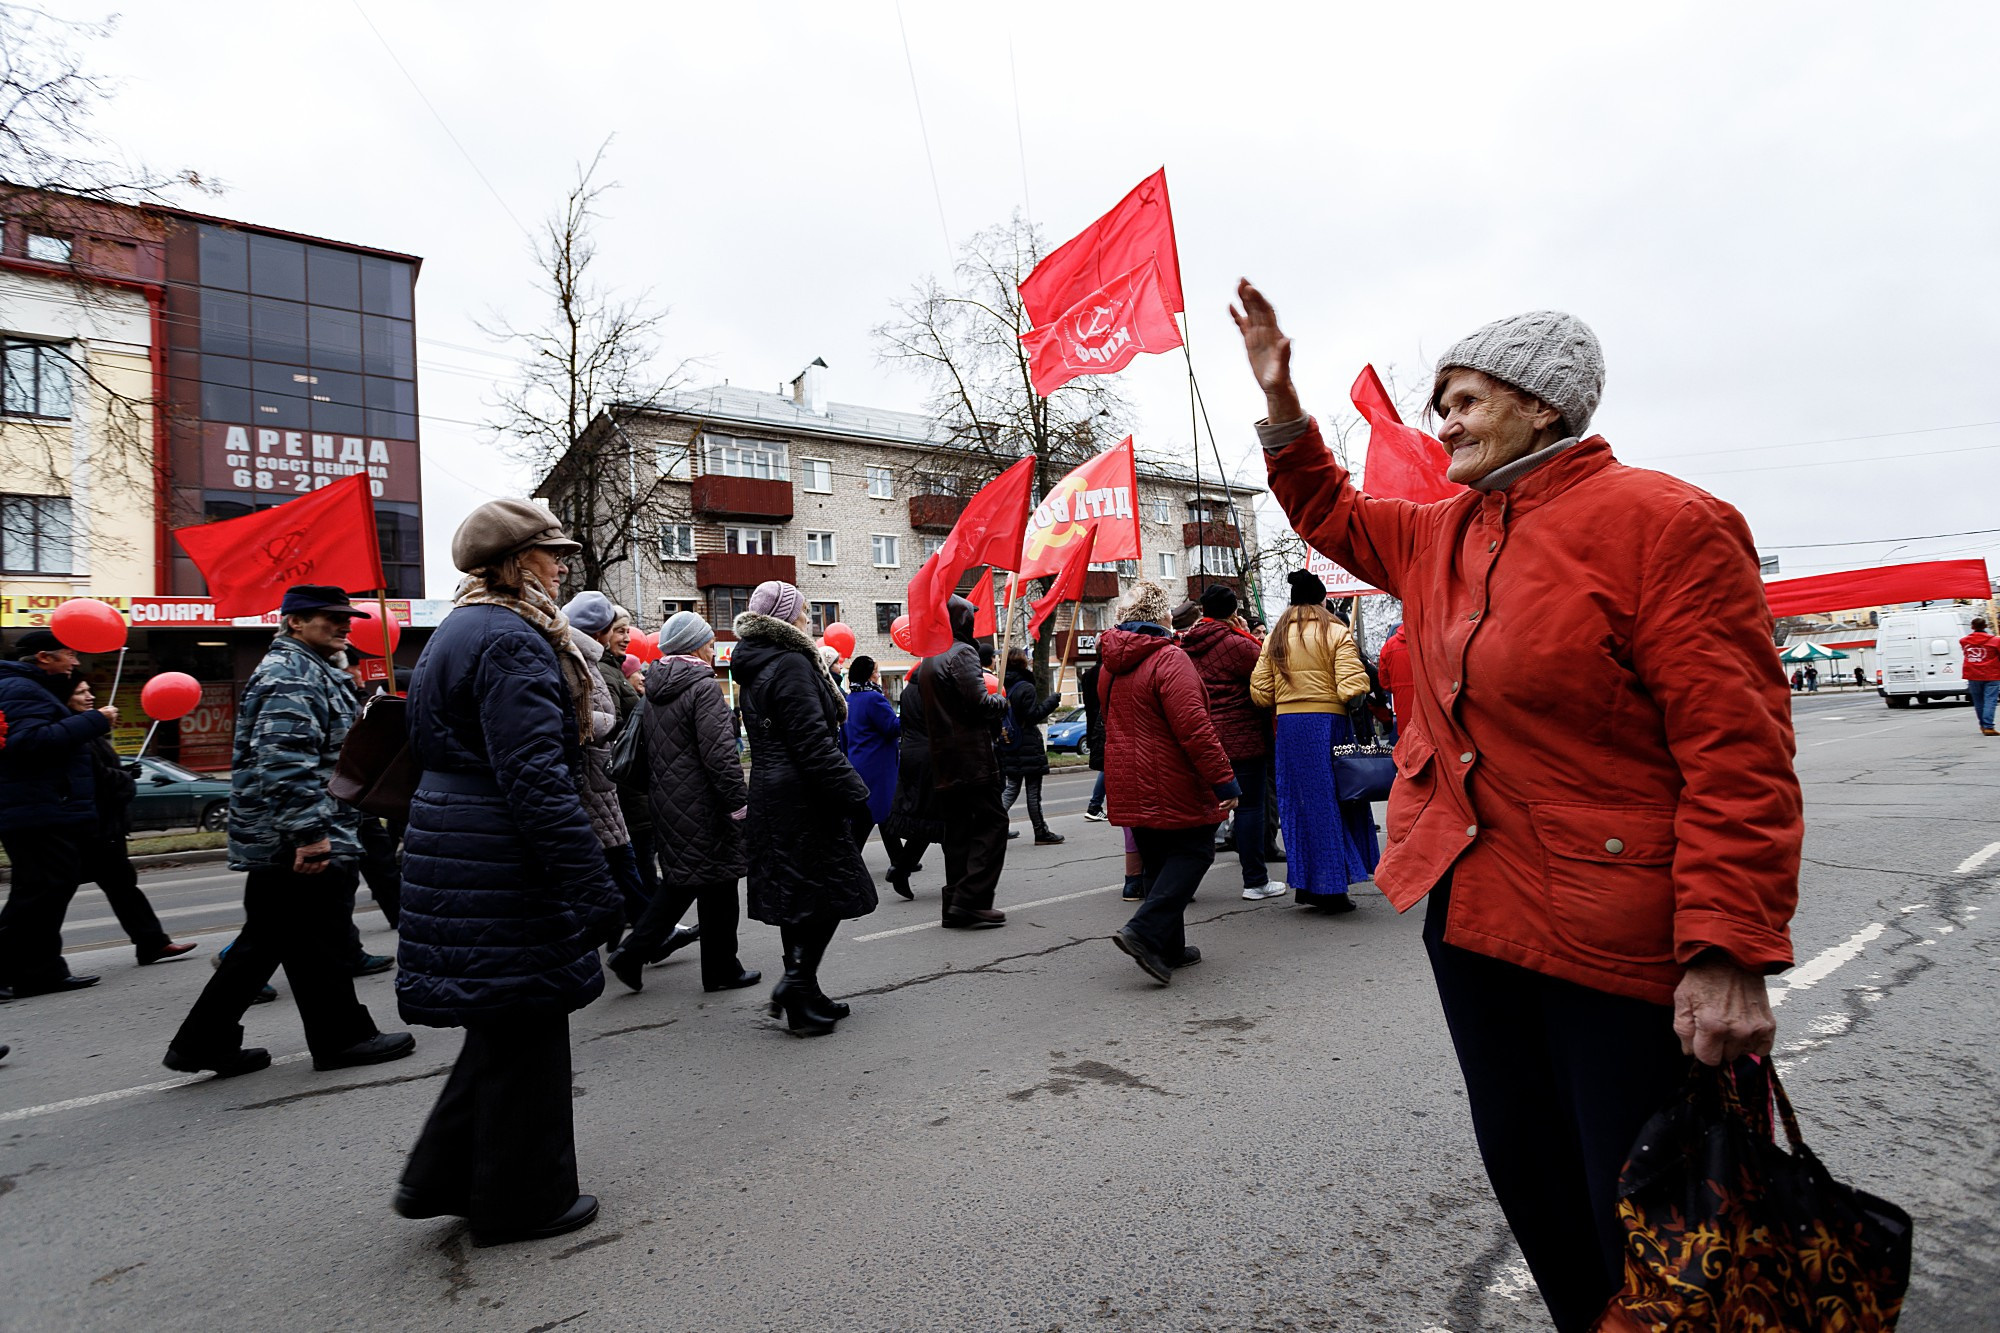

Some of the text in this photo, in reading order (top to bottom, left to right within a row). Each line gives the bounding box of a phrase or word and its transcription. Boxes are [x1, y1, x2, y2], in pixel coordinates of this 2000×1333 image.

[225, 426, 390, 465] АРЕНДА
[226, 454, 249, 467] ОТ
[233, 469, 384, 498] 68-200
[131, 603, 217, 622] СОЛЯРИ
